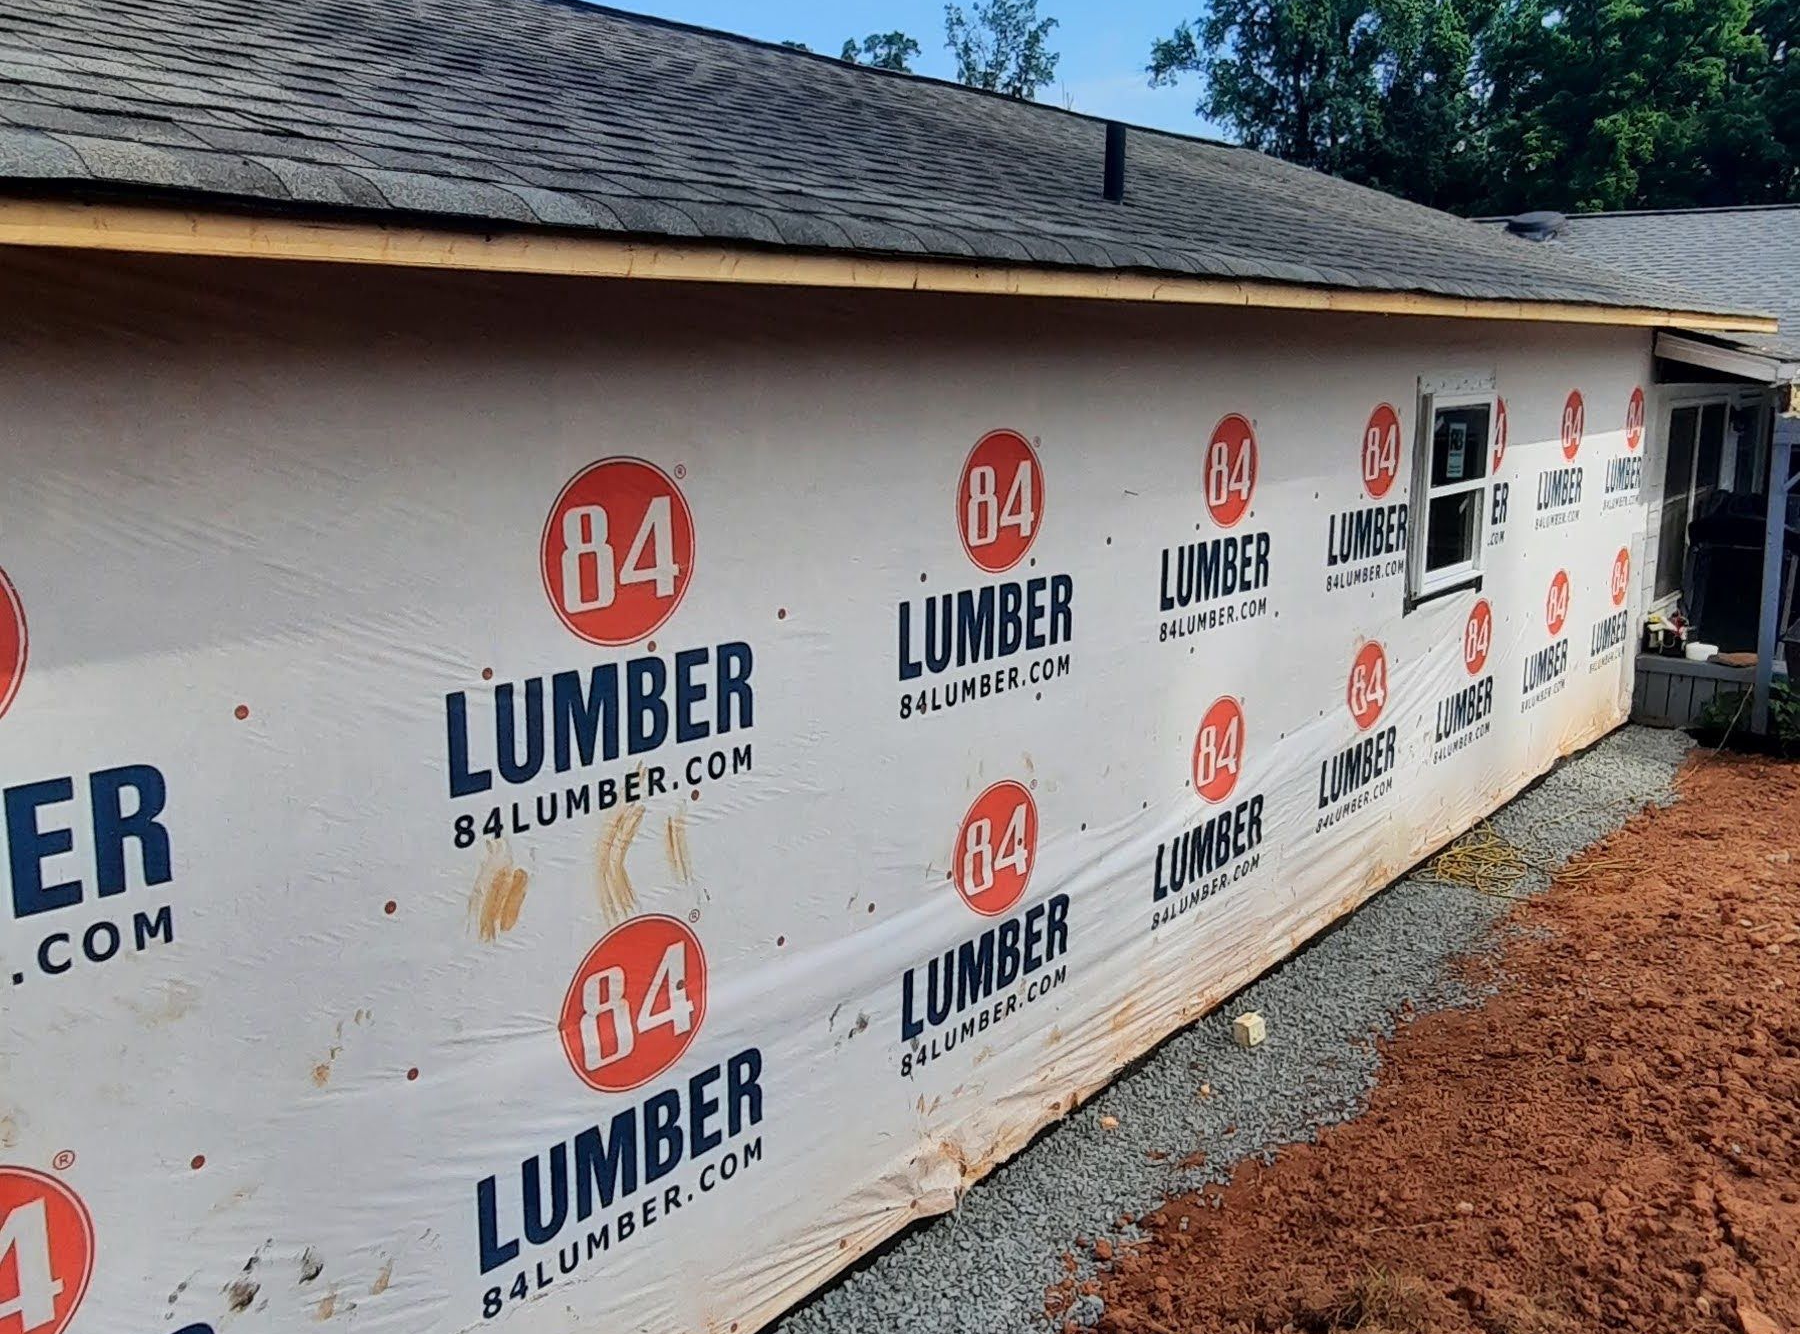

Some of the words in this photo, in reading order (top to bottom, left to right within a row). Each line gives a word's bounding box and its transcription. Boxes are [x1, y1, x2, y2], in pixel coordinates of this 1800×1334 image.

[1365, 424, 1396, 482] 84
[1563, 405, 1583, 448] 84
[967, 459, 1034, 548] 84
[1209, 438, 1251, 506] 84
[1537, 466, 1583, 511] LUMBER
[1605, 456, 1641, 494] LUMBER
[561, 495, 679, 615] 84
[1327, 503, 1408, 566] LUMBER
[1159, 531, 1271, 611] LUMBER
[1326, 559, 1404, 592] 84LUMBER.COM
[1548, 582, 1568, 626] 84
[1612, 558, 1629, 596] 84
[898, 573, 1073, 681] LUMBER
[1159, 597, 1267, 642] 84LUMBER.COM
[1466, 616, 1490, 664] 84
[1591, 609, 1628, 657] LUMBER
[900, 653, 1071, 719] 84LUMBER.COM
[1351, 657, 1385, 717] 84
[1522, 638, 1568, 695] LUMBER
[446, 640, 755, 799] LUMBER
[1433, 721, 1491, 765] 84LUMBER.COM
[1435, 675, 1494, 744] LUMBER
[1197, 720, 1239, 788] 84
[1318, 725, 1397, 809] LUMBER
[453, 743, 753, 850] 84LUMBER.COM
[1315, 776, 1393, 834] 84LUMBER.COM
[963, 802, 1029, 897] 84
[1153, 793, 1265, 902] LUMBER
[1151, 853, 1261, 931] 84LUMBER.COM
[901, 892, 1071, 1043] LUMBER
[580, 940, 694, 1072] 84
[901, 965, 1067, 1078] 84LUMBER.COM
[477, 1047, 763, 1276] LUMBER
[482, 1136, 762, 1319] 84LUMBER.COM
